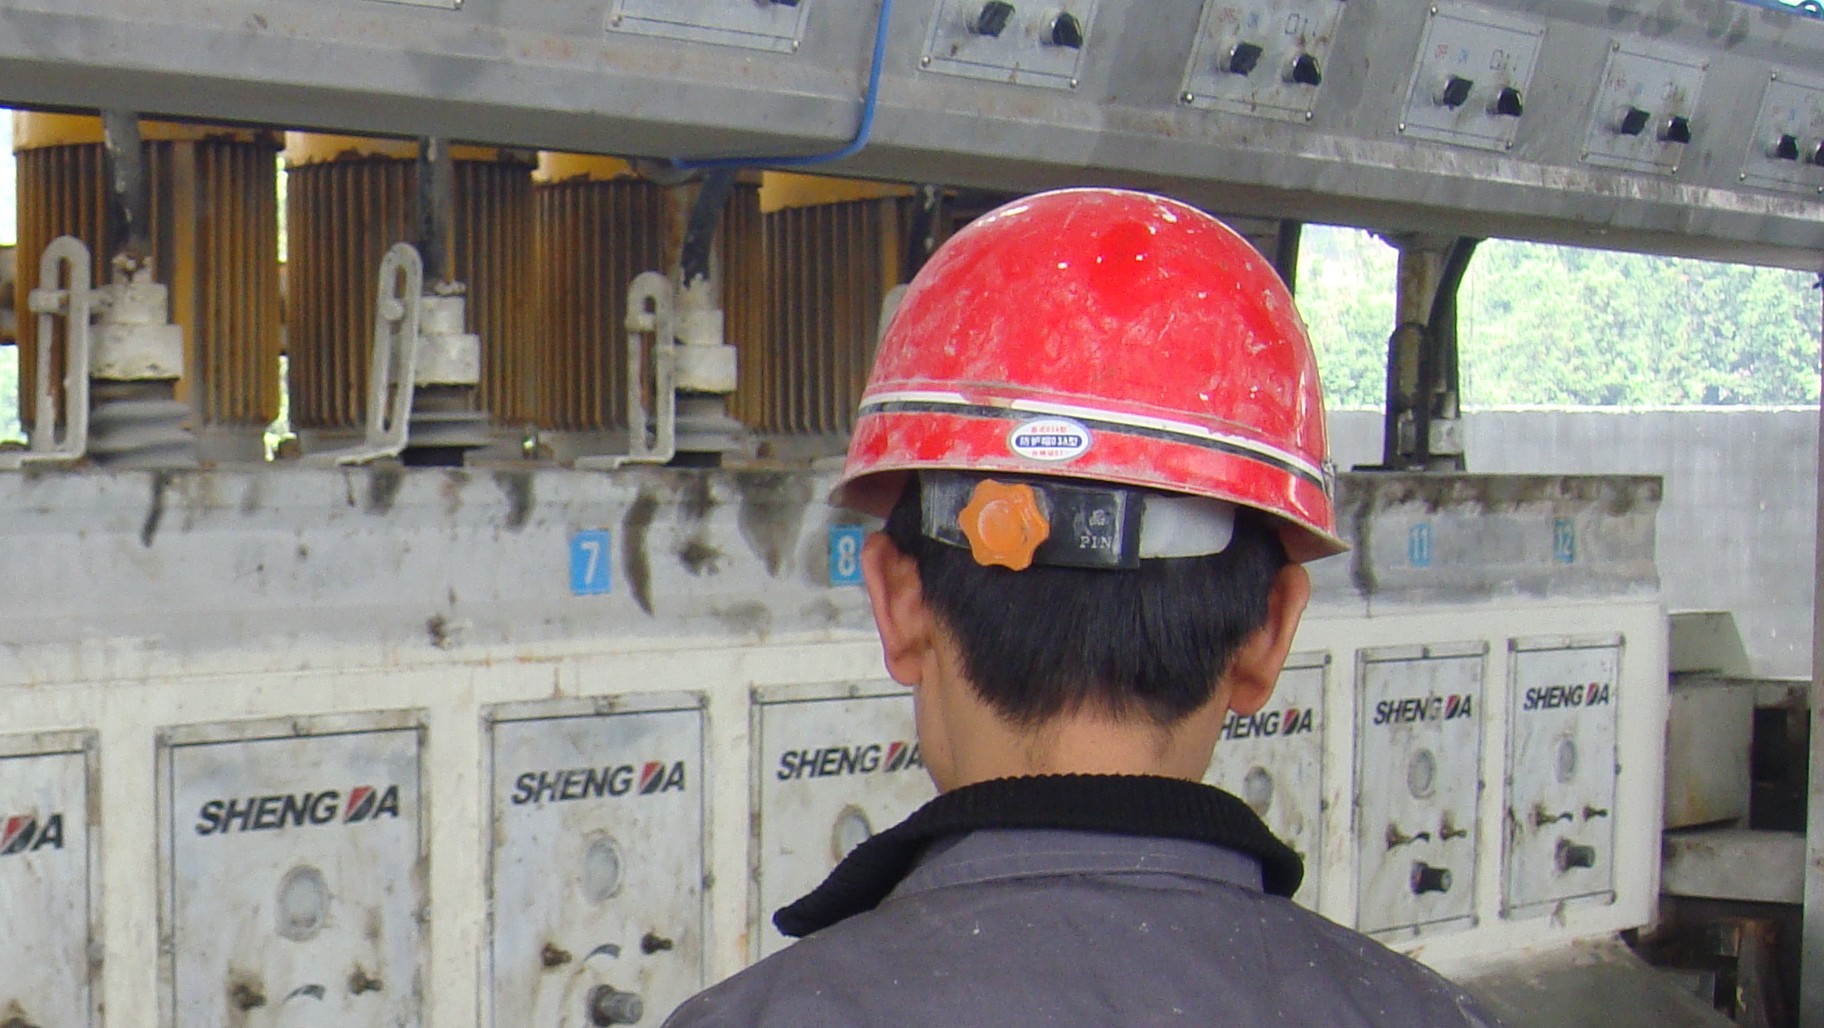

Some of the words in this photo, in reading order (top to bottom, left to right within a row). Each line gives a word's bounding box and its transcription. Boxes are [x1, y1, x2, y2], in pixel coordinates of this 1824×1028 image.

[580, 541, 603, 586] 7
[837, 535, 857, 578] 8
[1222, 707, 1313, 740] HENGDA
